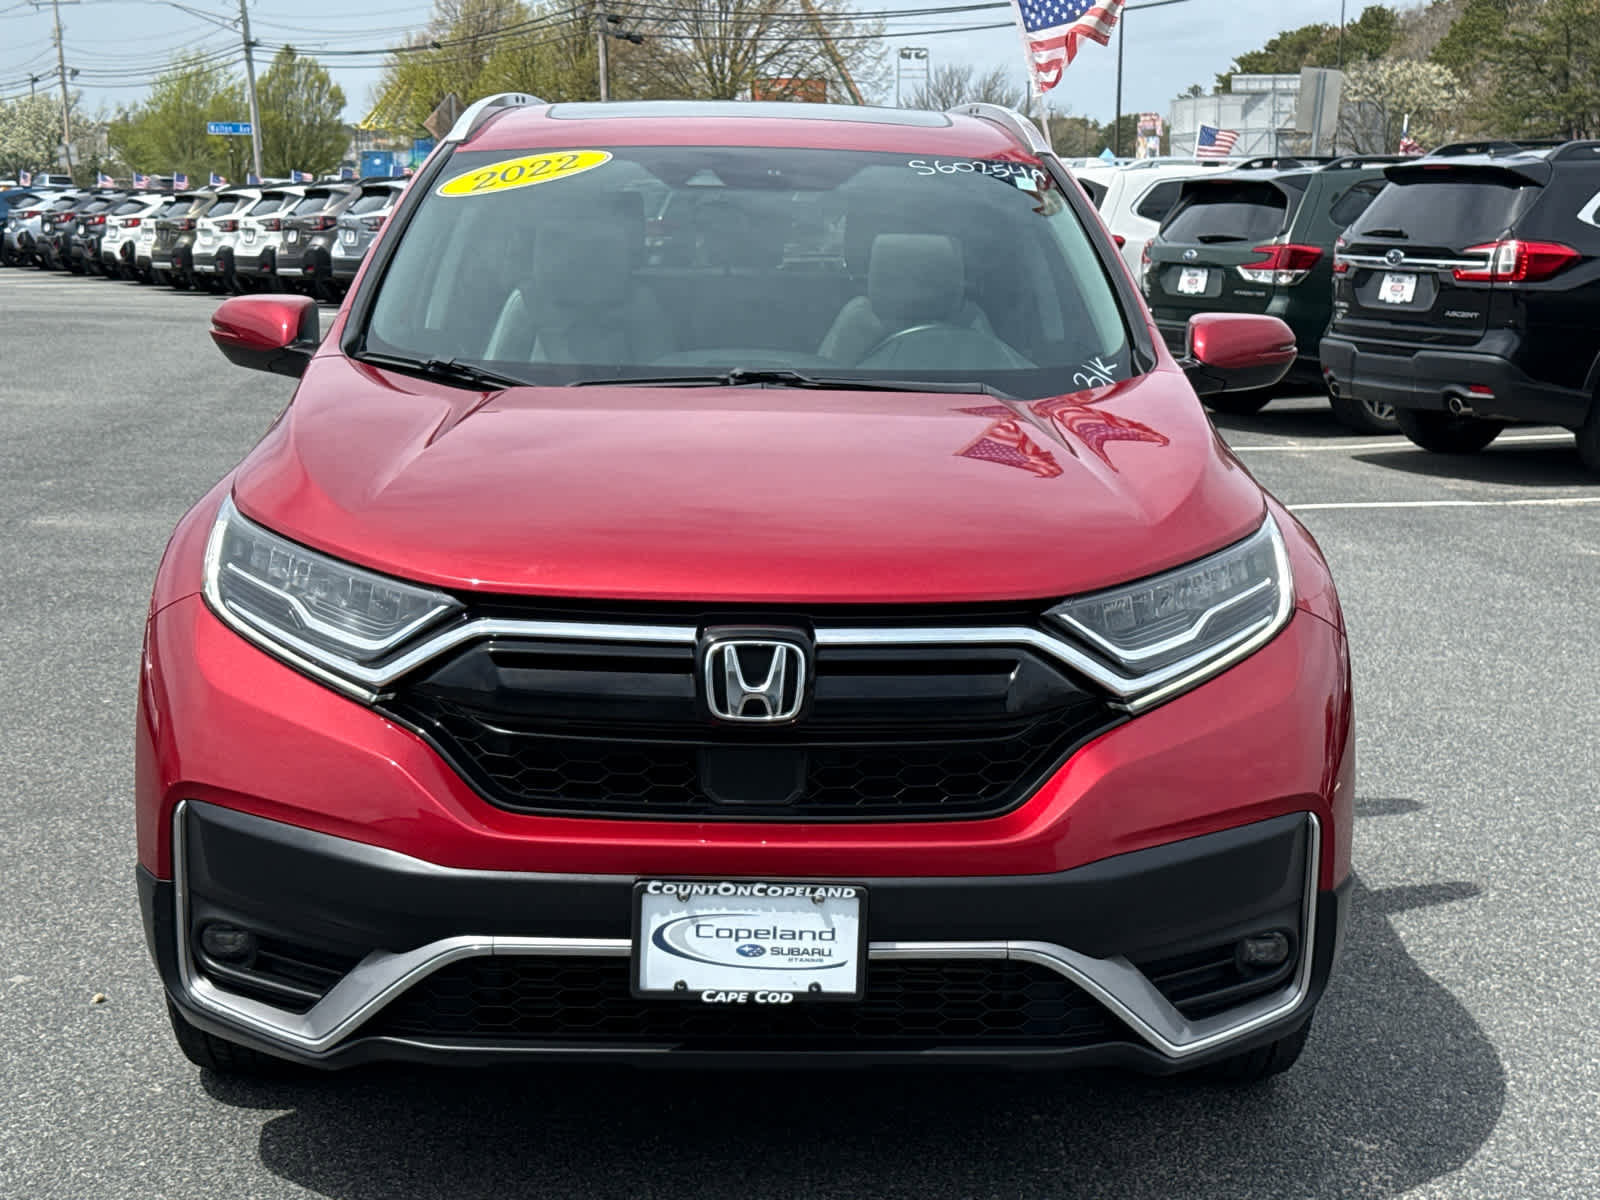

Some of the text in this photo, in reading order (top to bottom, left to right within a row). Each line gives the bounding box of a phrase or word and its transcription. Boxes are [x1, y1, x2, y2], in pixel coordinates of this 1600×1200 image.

[472, 154, 580, 191] 2022
[908, 159, 1047, 182] S60254A
[695, 924, 836, 943] Copeland
[770, 946, 832, 957] SUBARU
[701, 990, 793, 1004] CAPE COD
